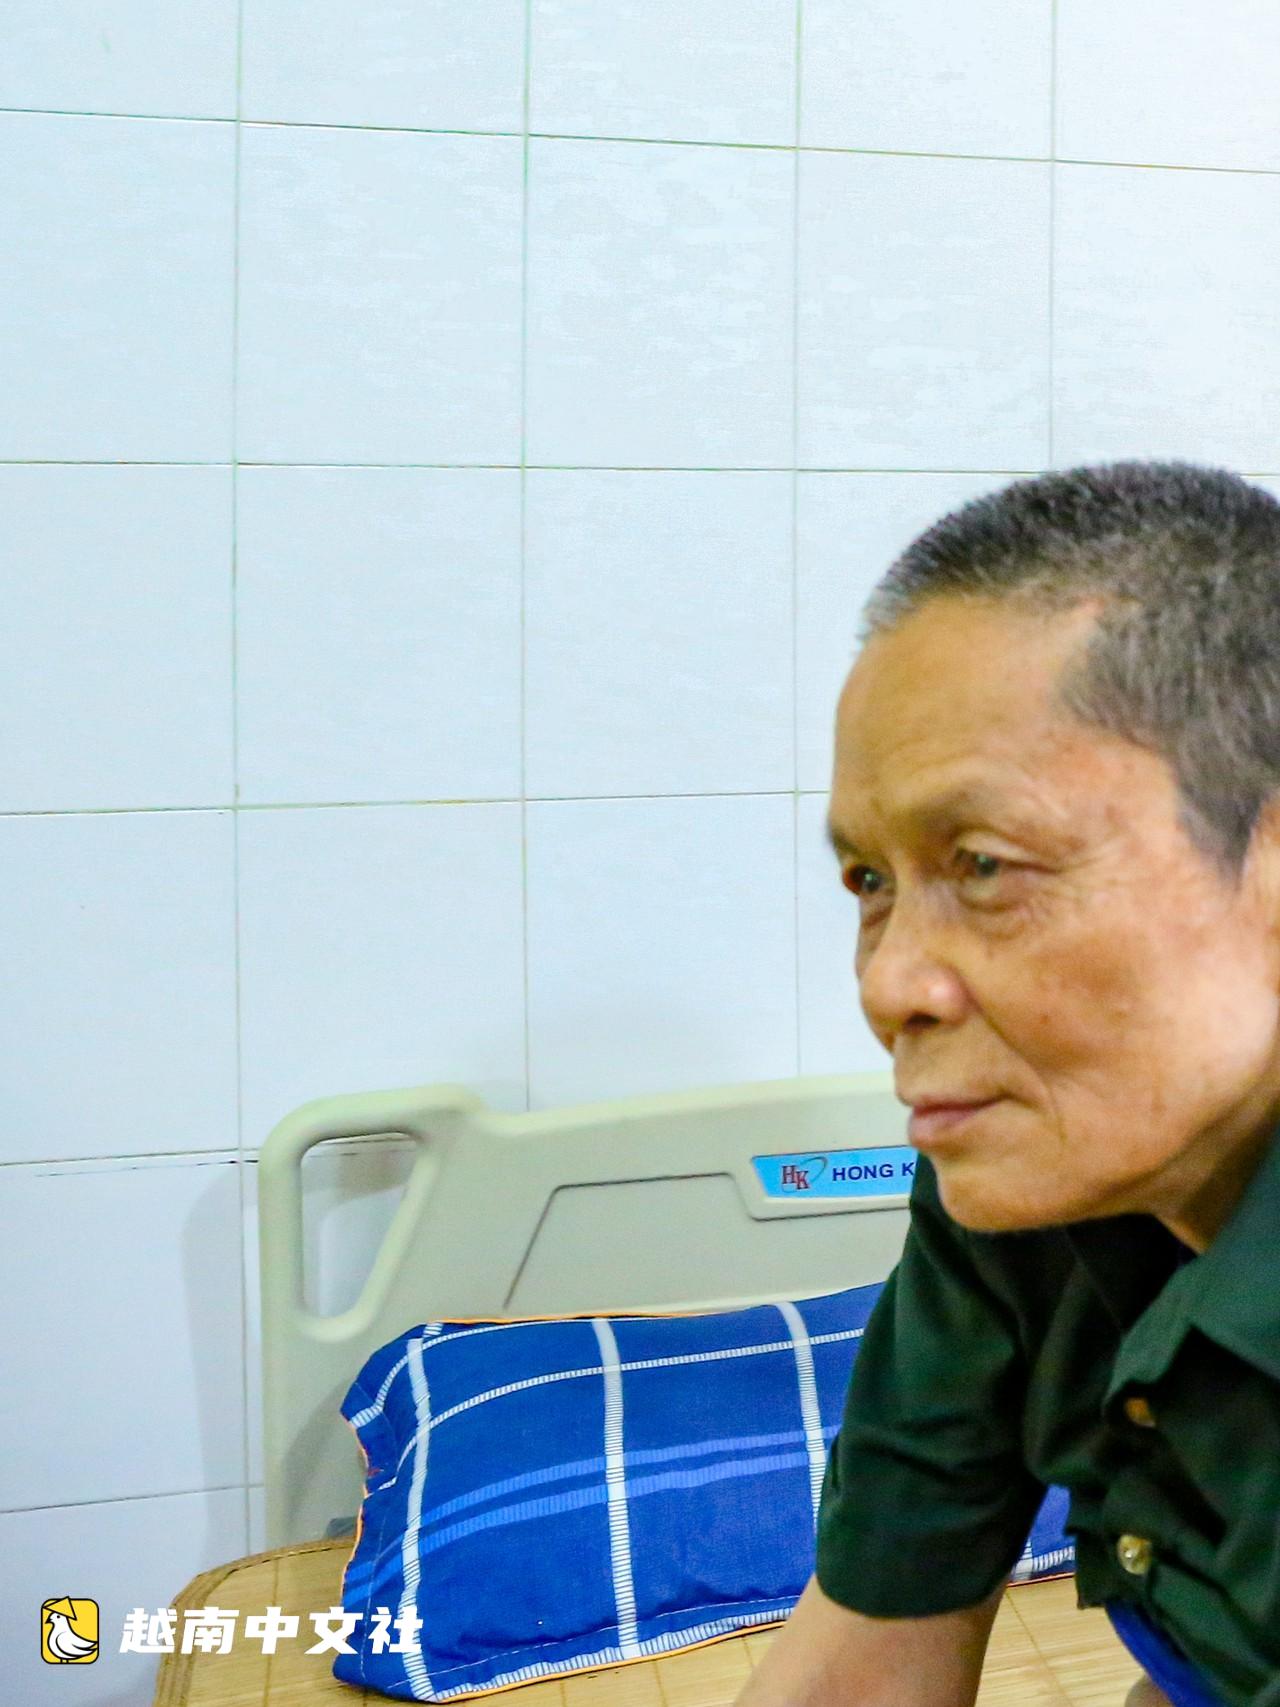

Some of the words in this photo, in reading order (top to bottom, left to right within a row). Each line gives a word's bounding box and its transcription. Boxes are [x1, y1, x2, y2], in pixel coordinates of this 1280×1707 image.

[781, 1165, 810, 1190] HK
[832, 1163, 893, 1182] HONG
[902, 1162, 915, 1177] K
